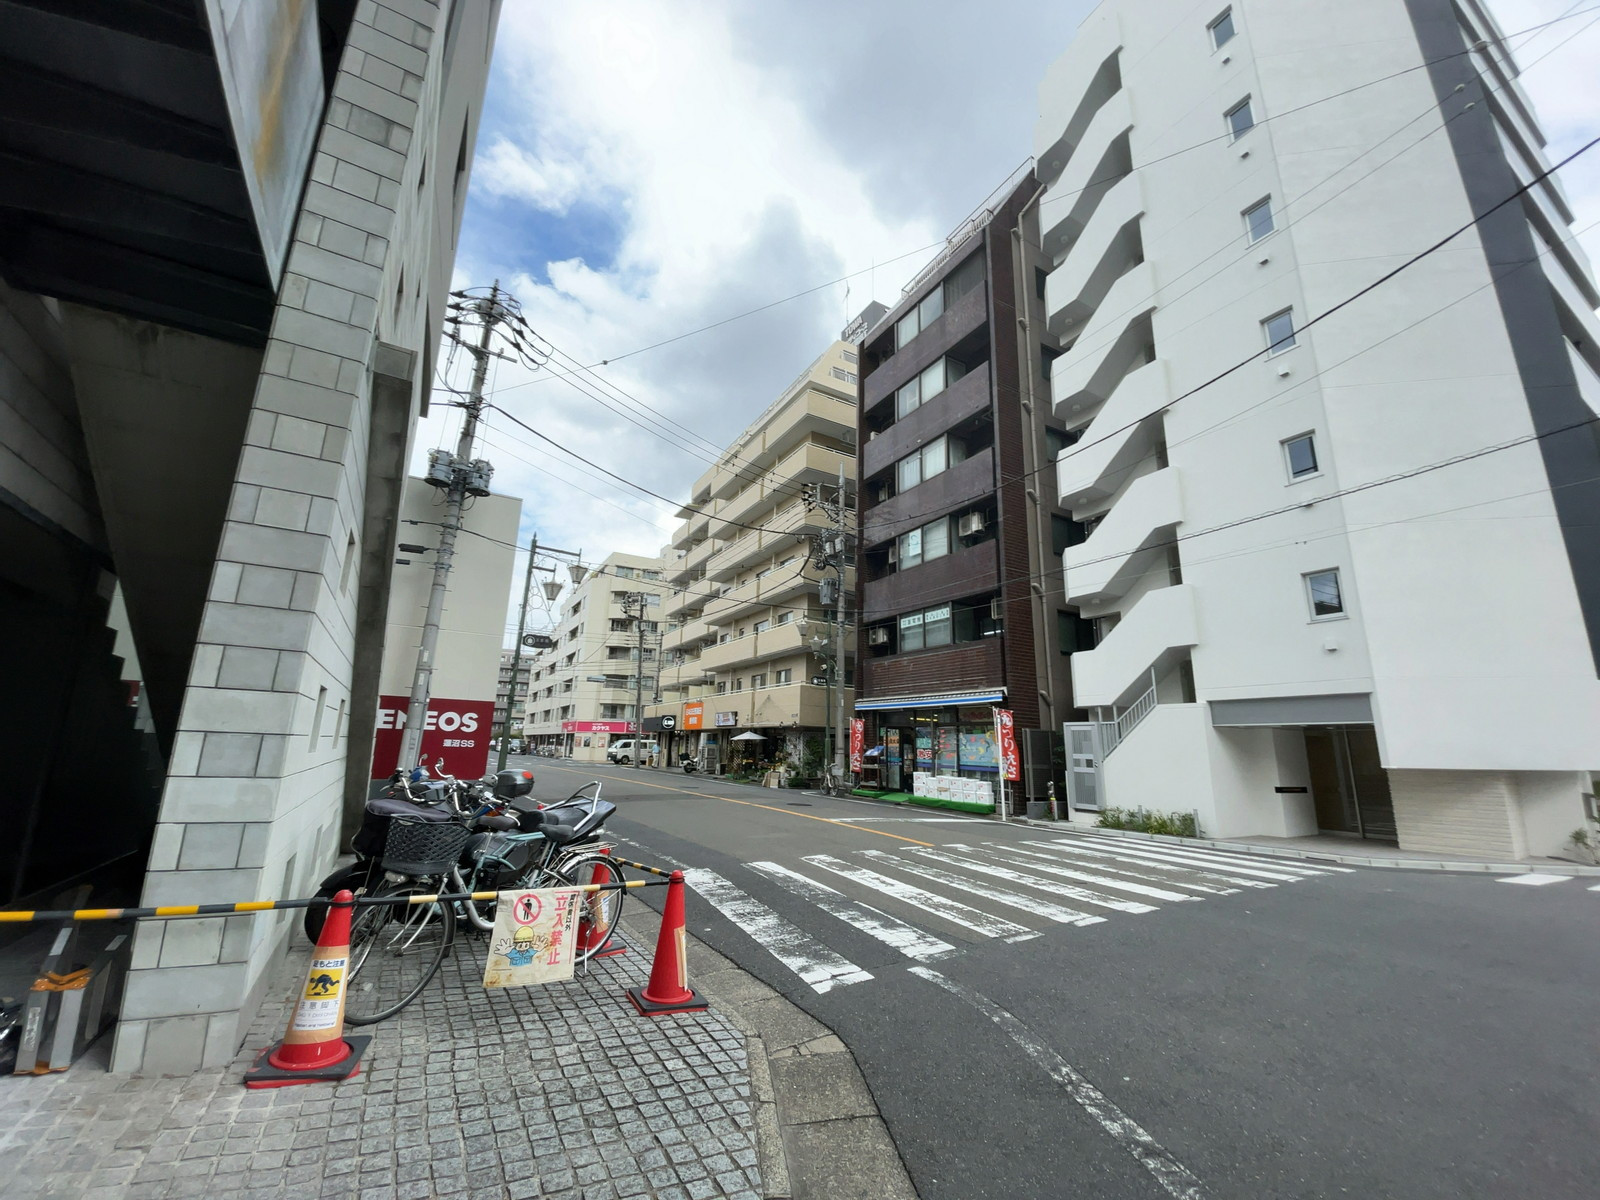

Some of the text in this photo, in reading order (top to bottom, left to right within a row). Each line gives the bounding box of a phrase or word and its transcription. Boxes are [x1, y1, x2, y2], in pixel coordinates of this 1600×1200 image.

[376, 709, 479, 733] ENEOS
[547, 896, 568, 965] 立入禁止
